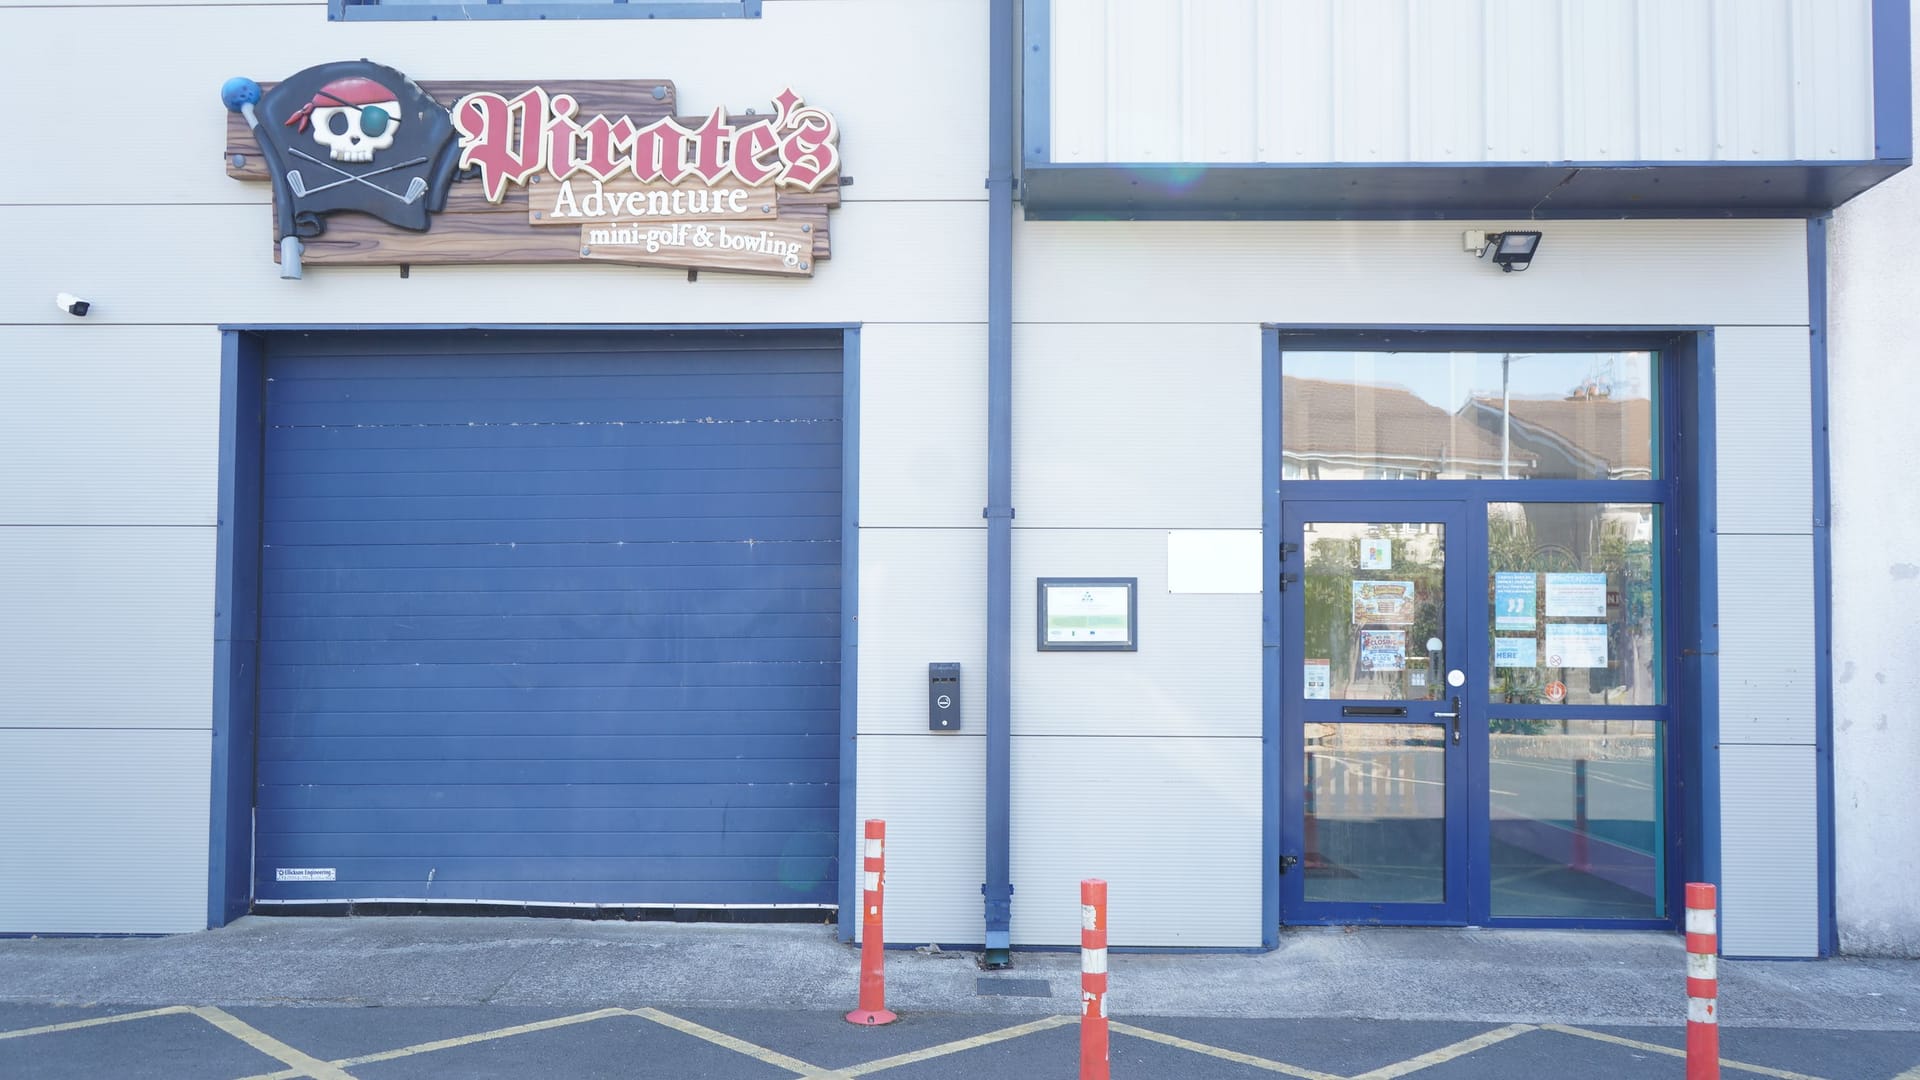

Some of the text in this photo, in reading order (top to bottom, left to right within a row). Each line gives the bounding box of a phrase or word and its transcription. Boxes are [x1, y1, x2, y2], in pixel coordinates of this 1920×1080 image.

[454, 85, 840, 203] Pirate's
[550, 179, 749, 218] Adventure
[588, 222, 803, 267] mini-golf & bowling
